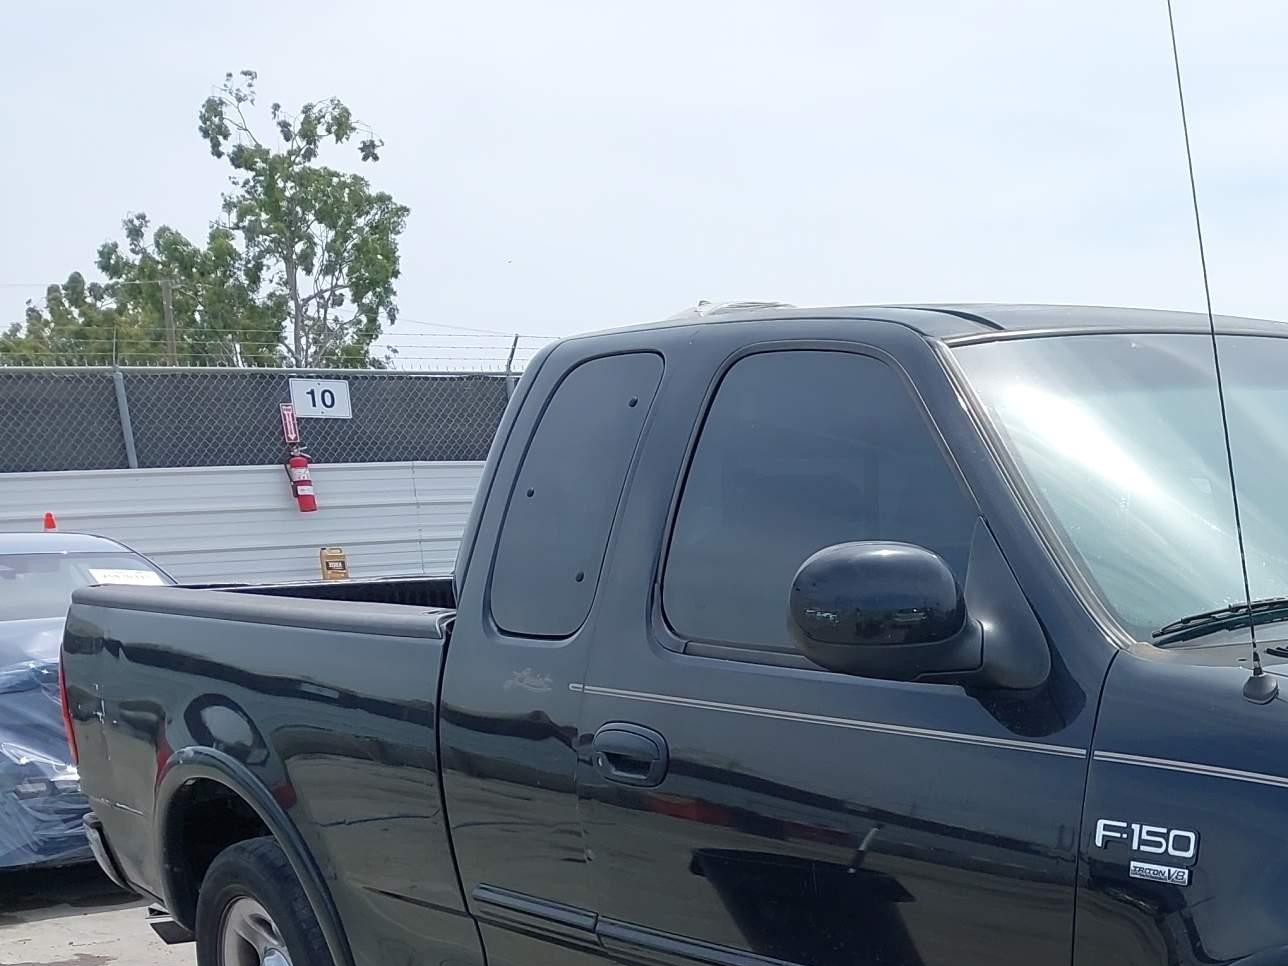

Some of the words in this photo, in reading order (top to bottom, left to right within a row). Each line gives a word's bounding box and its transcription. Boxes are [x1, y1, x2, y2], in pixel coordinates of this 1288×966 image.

[306, 388, 335, 409] 10
[1133, 865, 1167, 877] TRITON
[1167, 868, 1187, 882] V8
